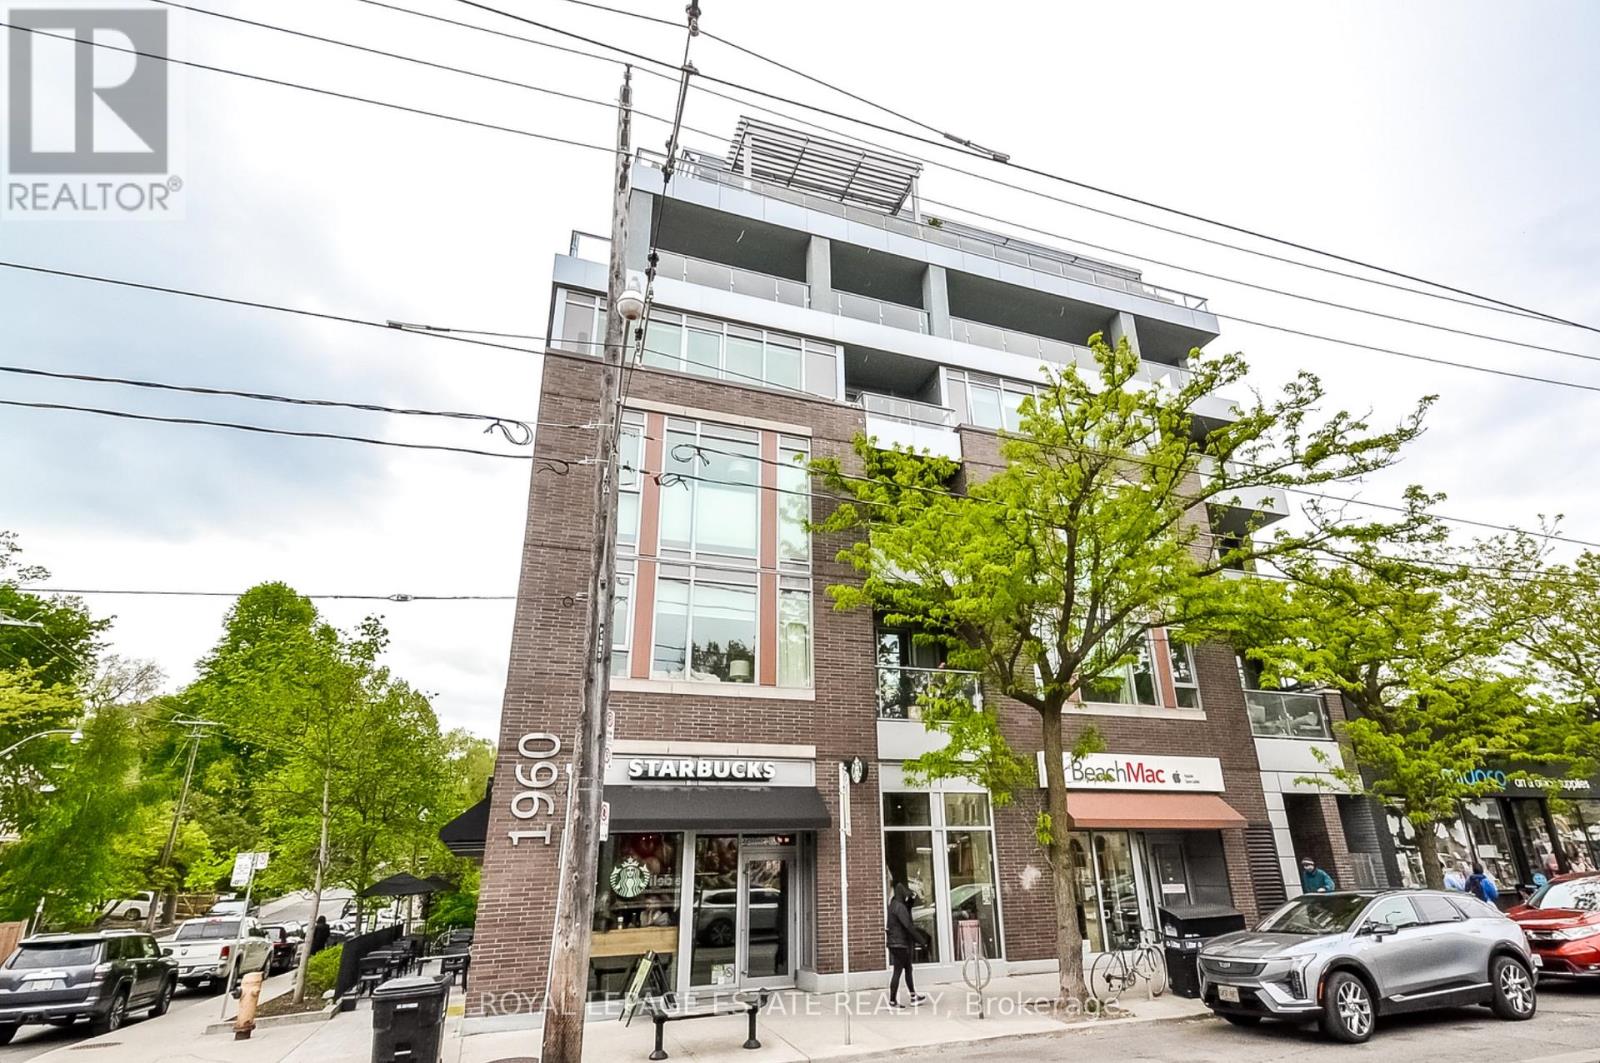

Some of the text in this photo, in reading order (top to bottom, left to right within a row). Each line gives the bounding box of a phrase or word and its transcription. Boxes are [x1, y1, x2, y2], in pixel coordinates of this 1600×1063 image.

[628, 758, 776, 779] STARBUCKS
[1070, 759, 1166, 784] BeachMac
[508, 732, 561, 846] 1960
